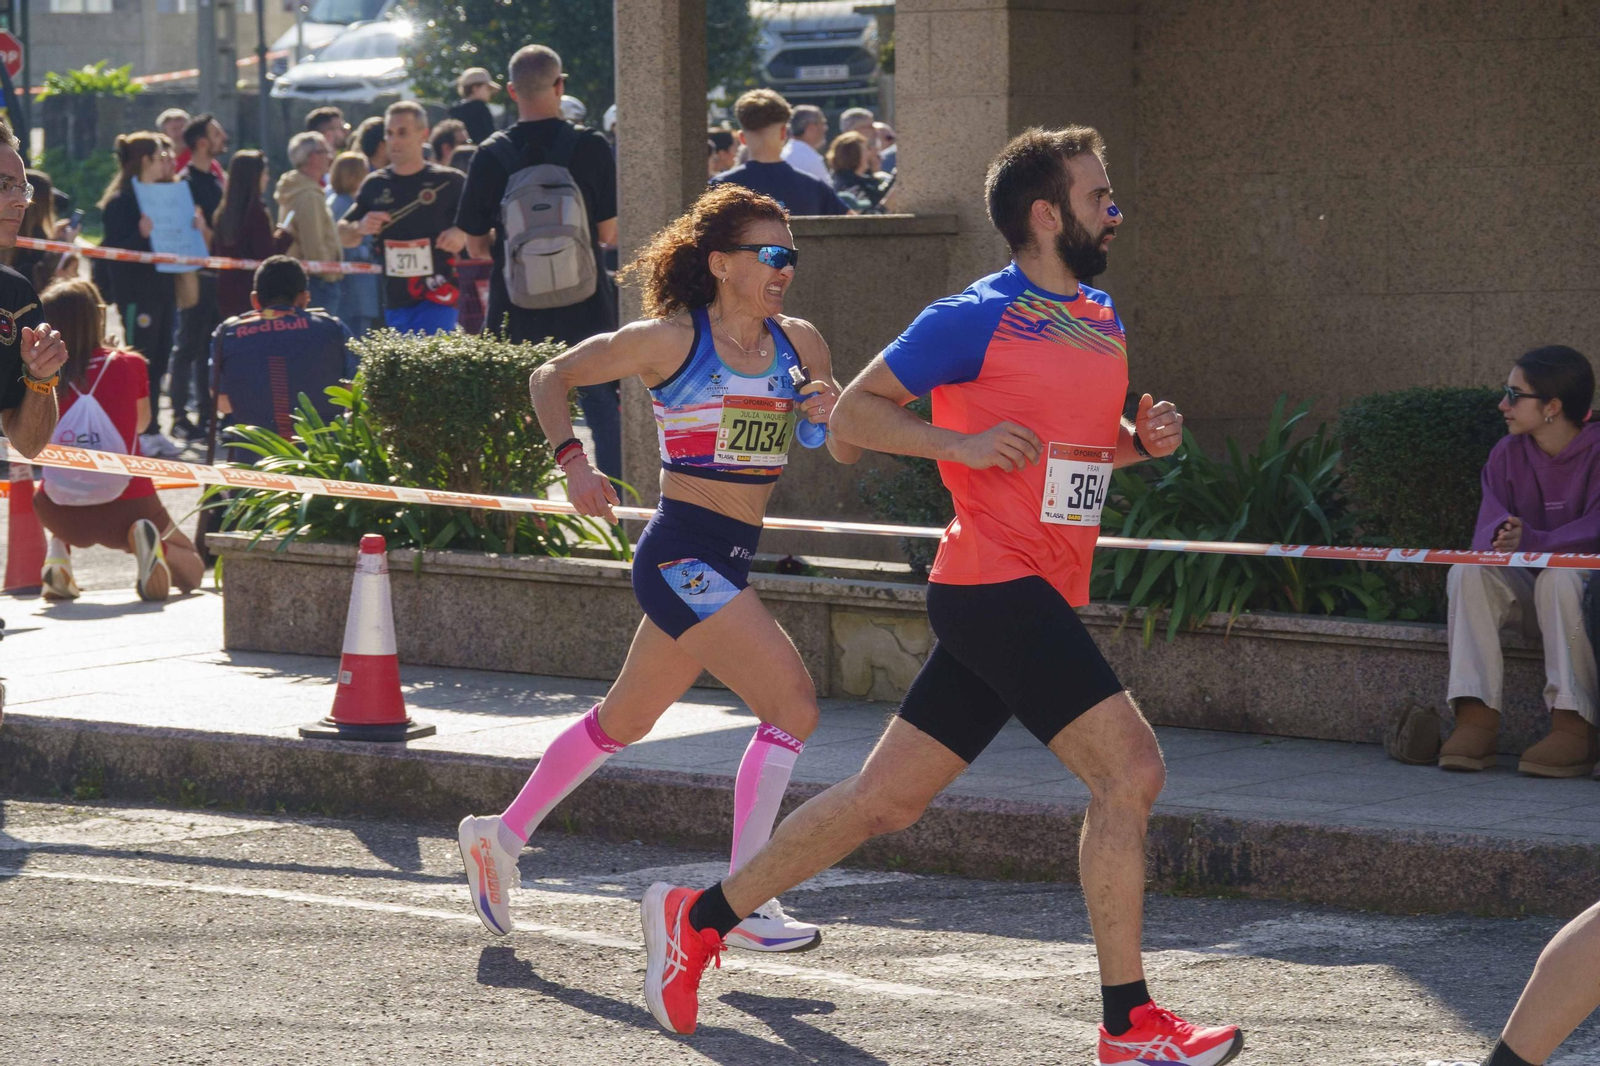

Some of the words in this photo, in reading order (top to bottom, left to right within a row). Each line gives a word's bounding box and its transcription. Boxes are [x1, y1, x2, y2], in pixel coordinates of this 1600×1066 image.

[396, 253, 418, 269] 371
[236, 320, 271, 338] Red
[273, 317, 309, 331] Bull
[740, 410, 760, 418] JULIA
[729, 419, 787, 452] 2034
[1087, 464, 1100, 472] FRAN
[1067, 473, 1103, 509] 364
